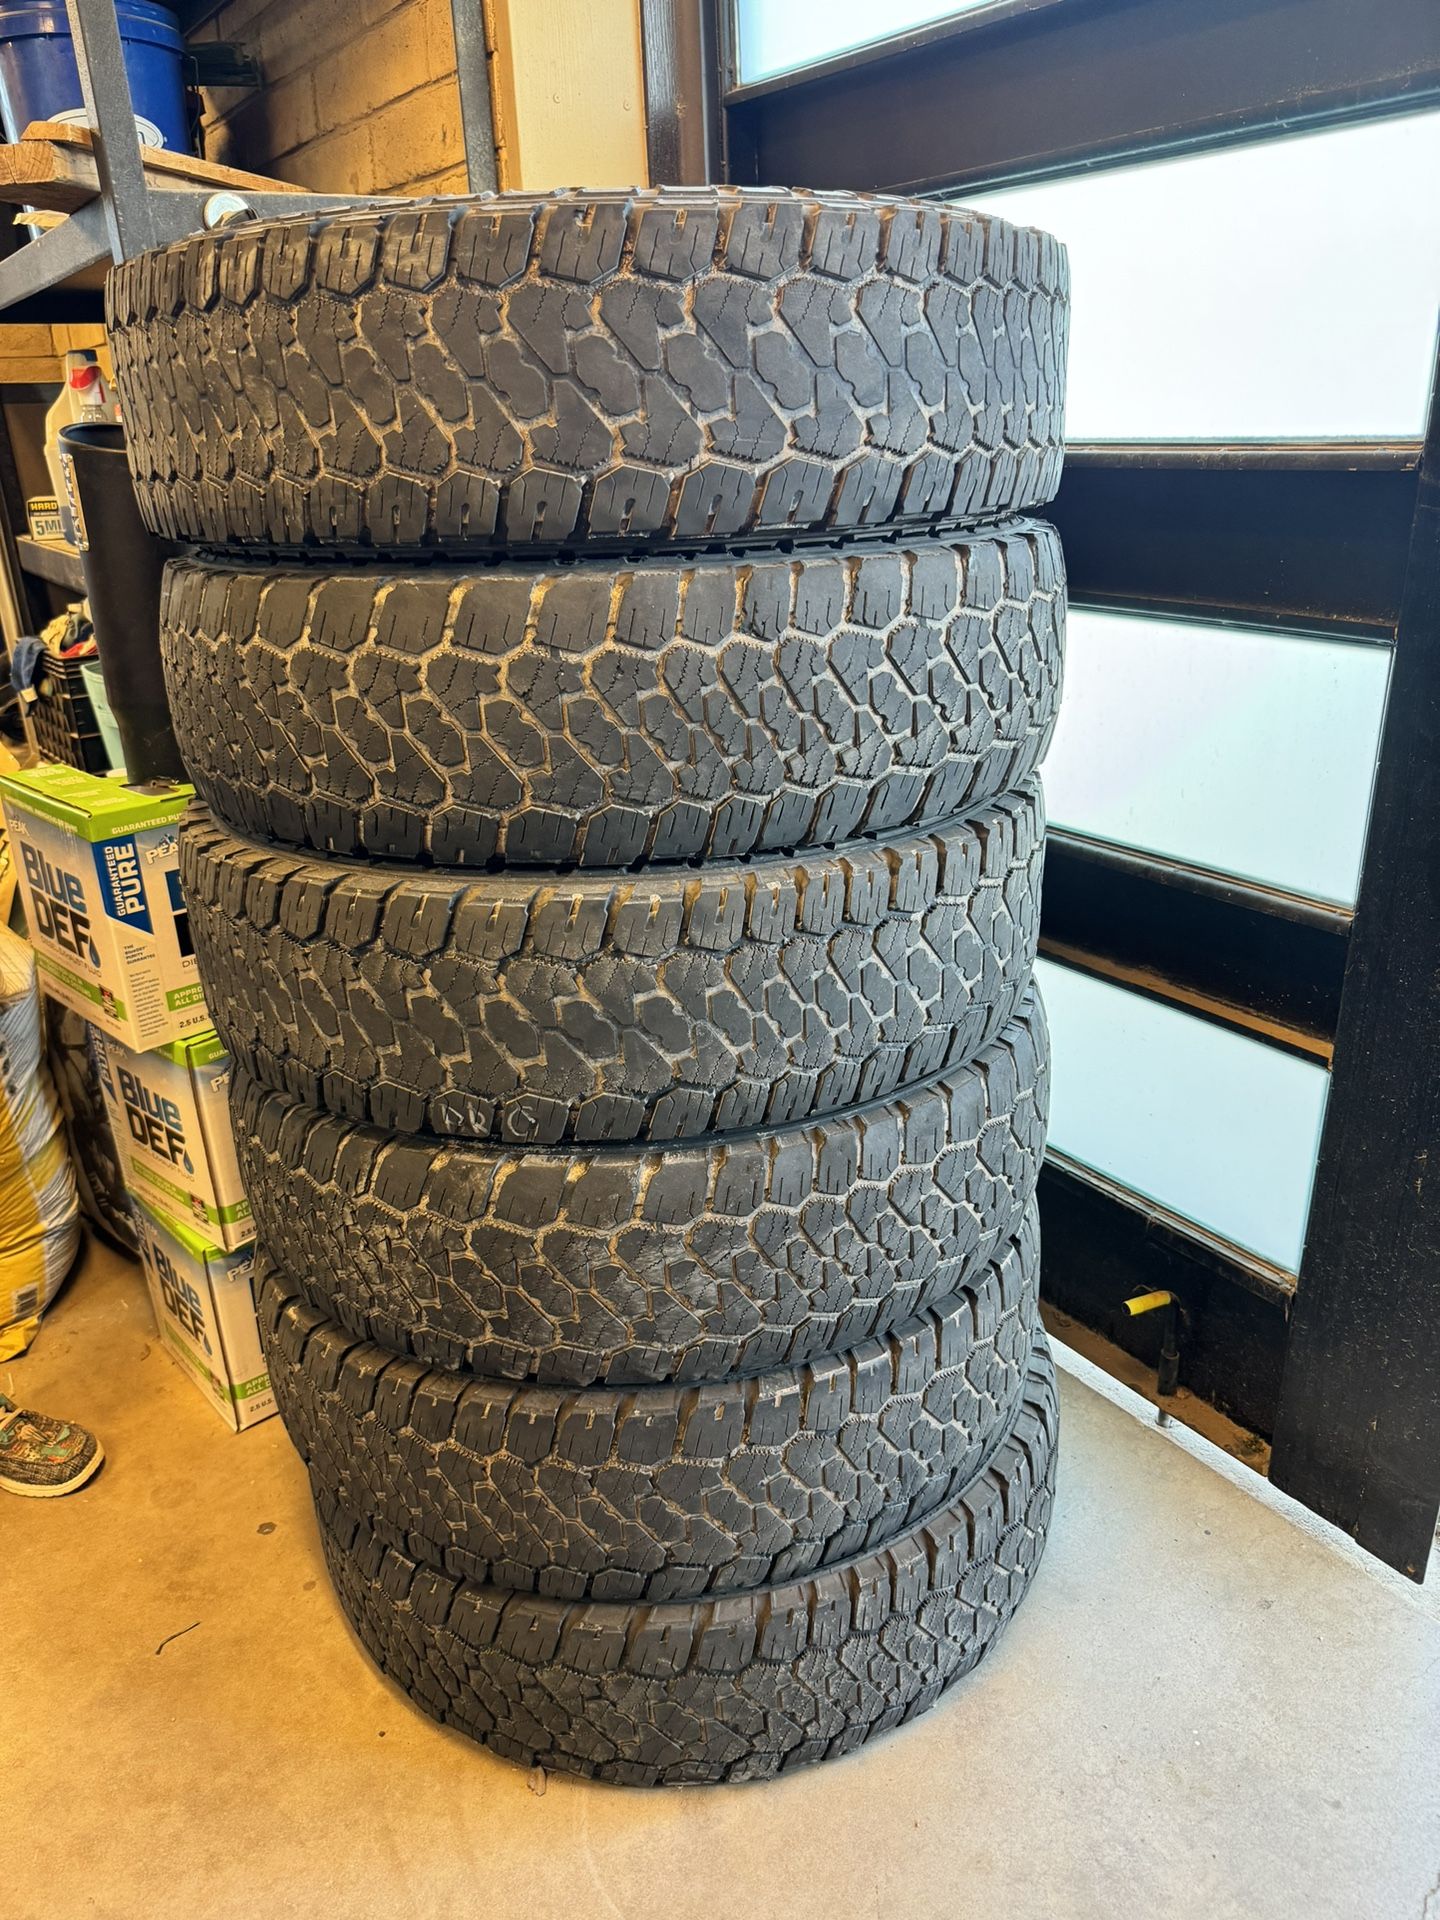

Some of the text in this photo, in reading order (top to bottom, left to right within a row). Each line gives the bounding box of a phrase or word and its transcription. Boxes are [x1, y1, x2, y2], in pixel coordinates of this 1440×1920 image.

[111, 812, 182, 835] GUARANTEED PU
[20, 840, 88, 914] Blue
[104, 845, 127, 917] GUARANTEED
[114, 843, 146, 915] PURE
[30, 887, 91, 959] DEF
[175, 997, 192, 1007] ALL
[179, 1019, 192, 1028] 2.5
[116, 1065, 183, 1132] Blue
[126, 1101, 186, 1165] DEF
[153, 1243, 203, 1318] Blue
[160, 1275, 206, 1348] DEF
